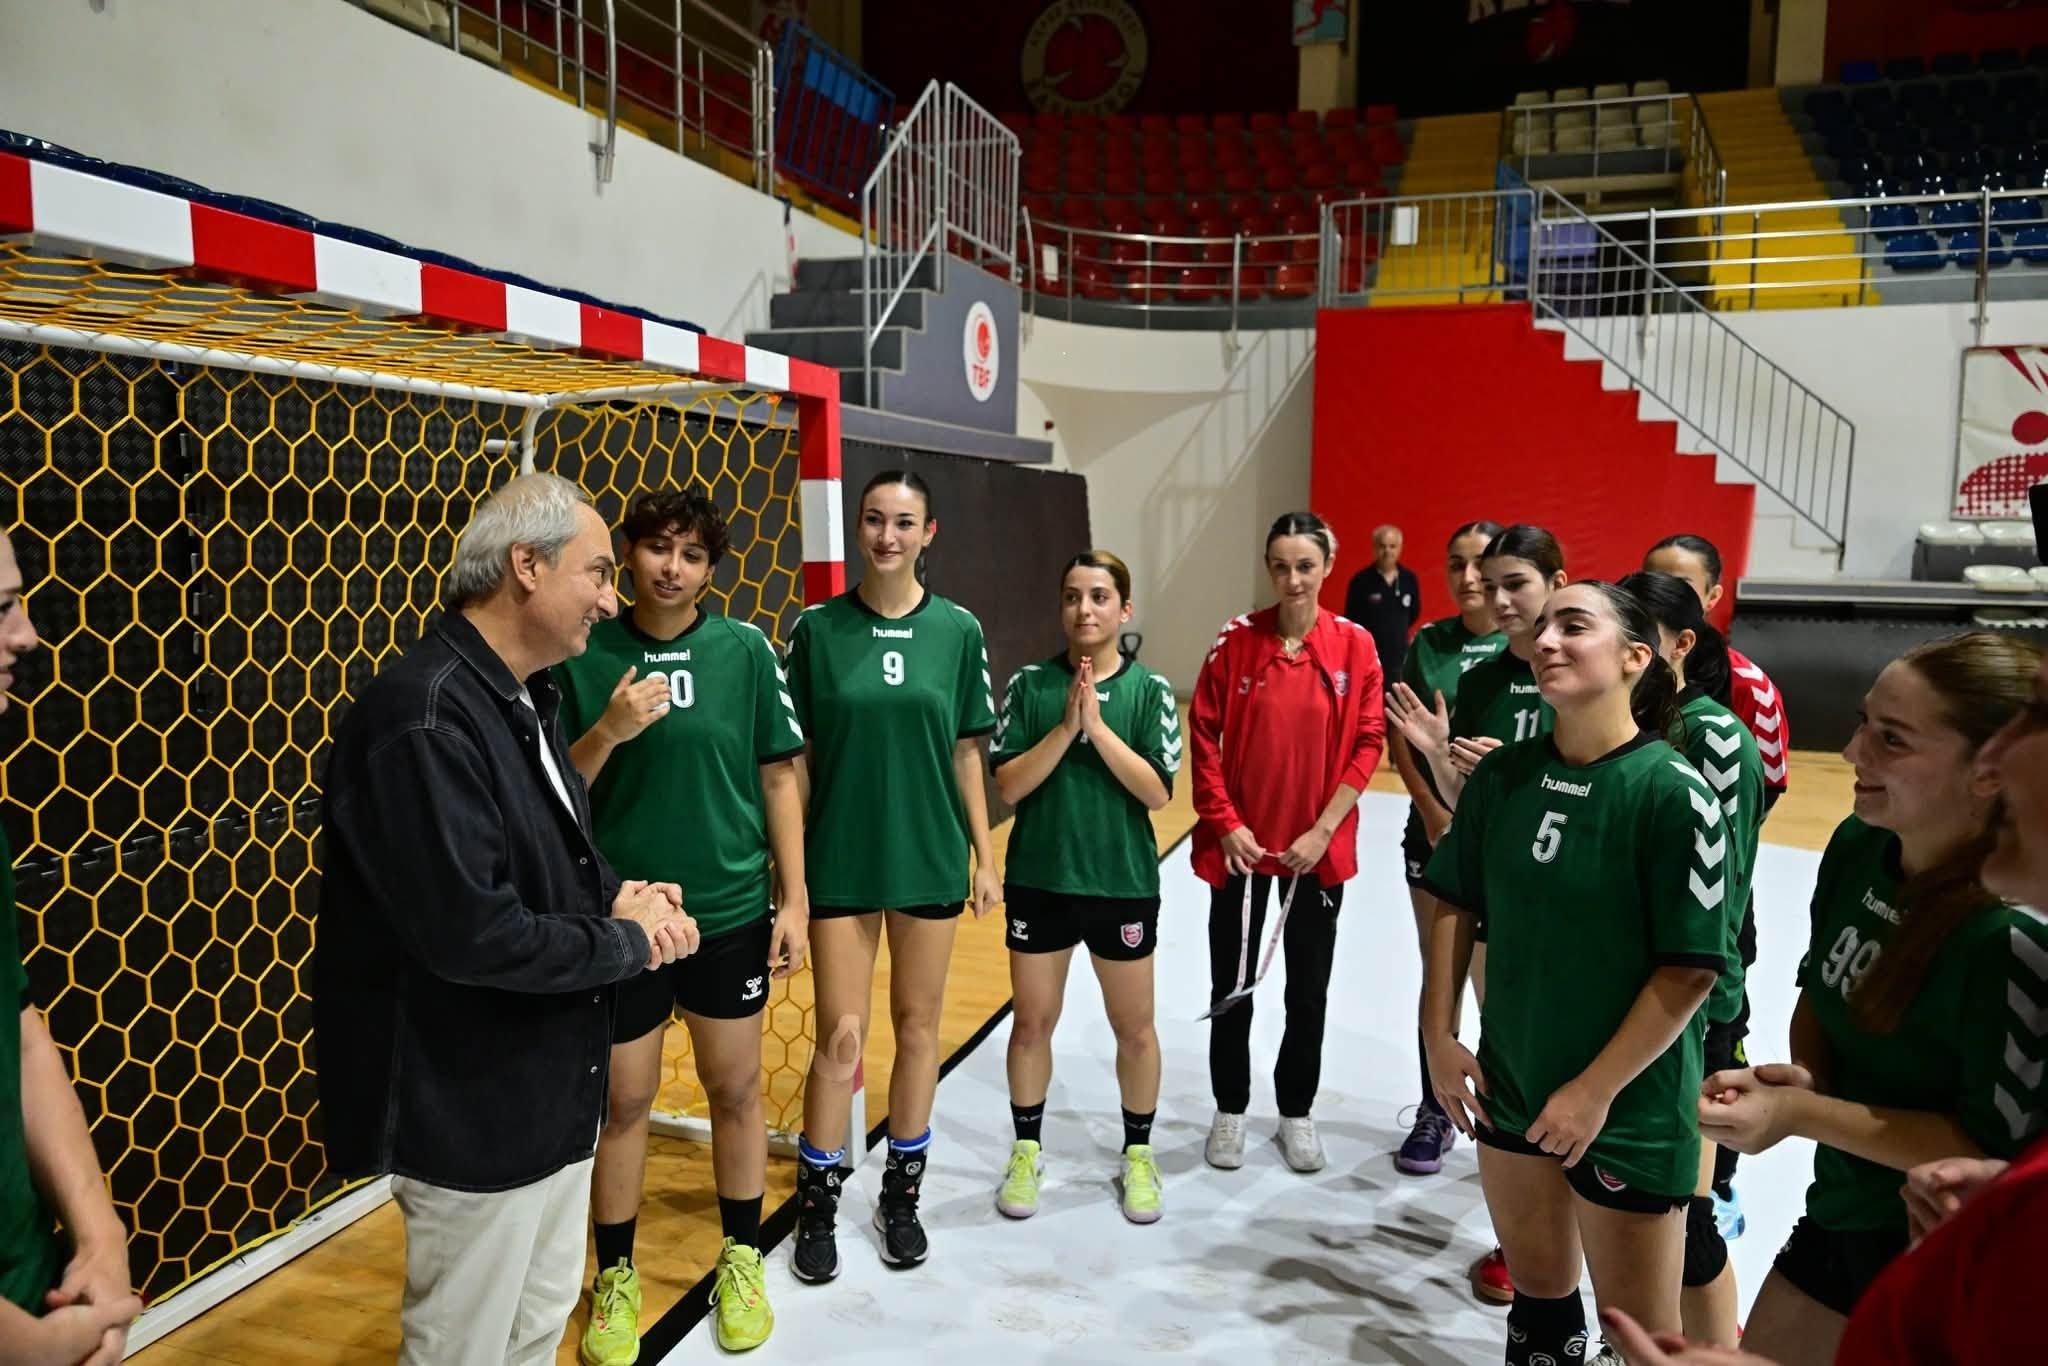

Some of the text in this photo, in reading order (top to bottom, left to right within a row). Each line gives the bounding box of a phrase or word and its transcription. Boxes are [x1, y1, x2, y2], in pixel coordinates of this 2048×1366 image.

[872, 626, 913, 639] hummel
[644, 649, 691, 663] hummel
[882, 650, 905, 686] 9
[1510, 682, 1541, 694] humm
[1514, 708, 1540, 743] 11
[1541, 773, 1593, 797] hummel
[1532, 810, 1569, 864] 5
[1861, 886, 1902, 925] humme
